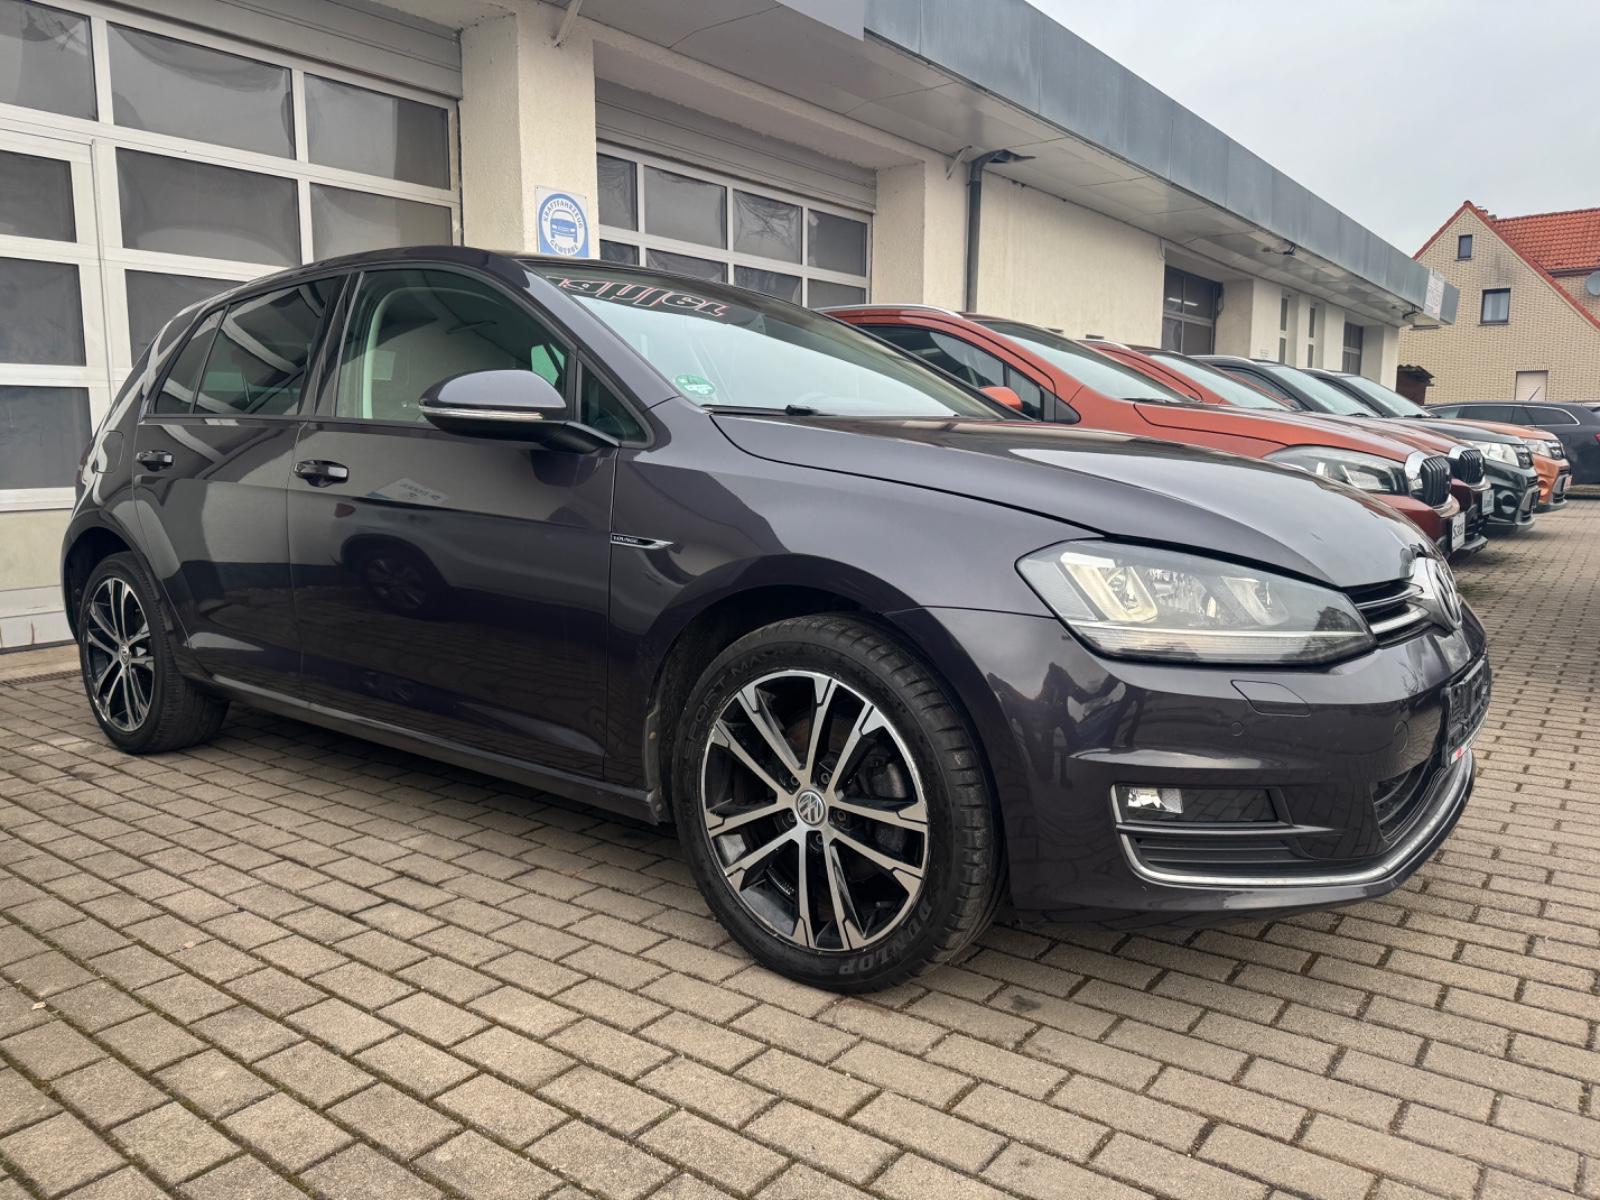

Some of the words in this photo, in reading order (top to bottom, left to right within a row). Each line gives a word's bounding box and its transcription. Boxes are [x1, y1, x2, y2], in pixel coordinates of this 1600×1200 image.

[543, 199, 583, 228] KRAFTFAHRZEUG
[549, 239, 578, 254] GEWERBE
[839, 899, 932, 975] DUNLOP
